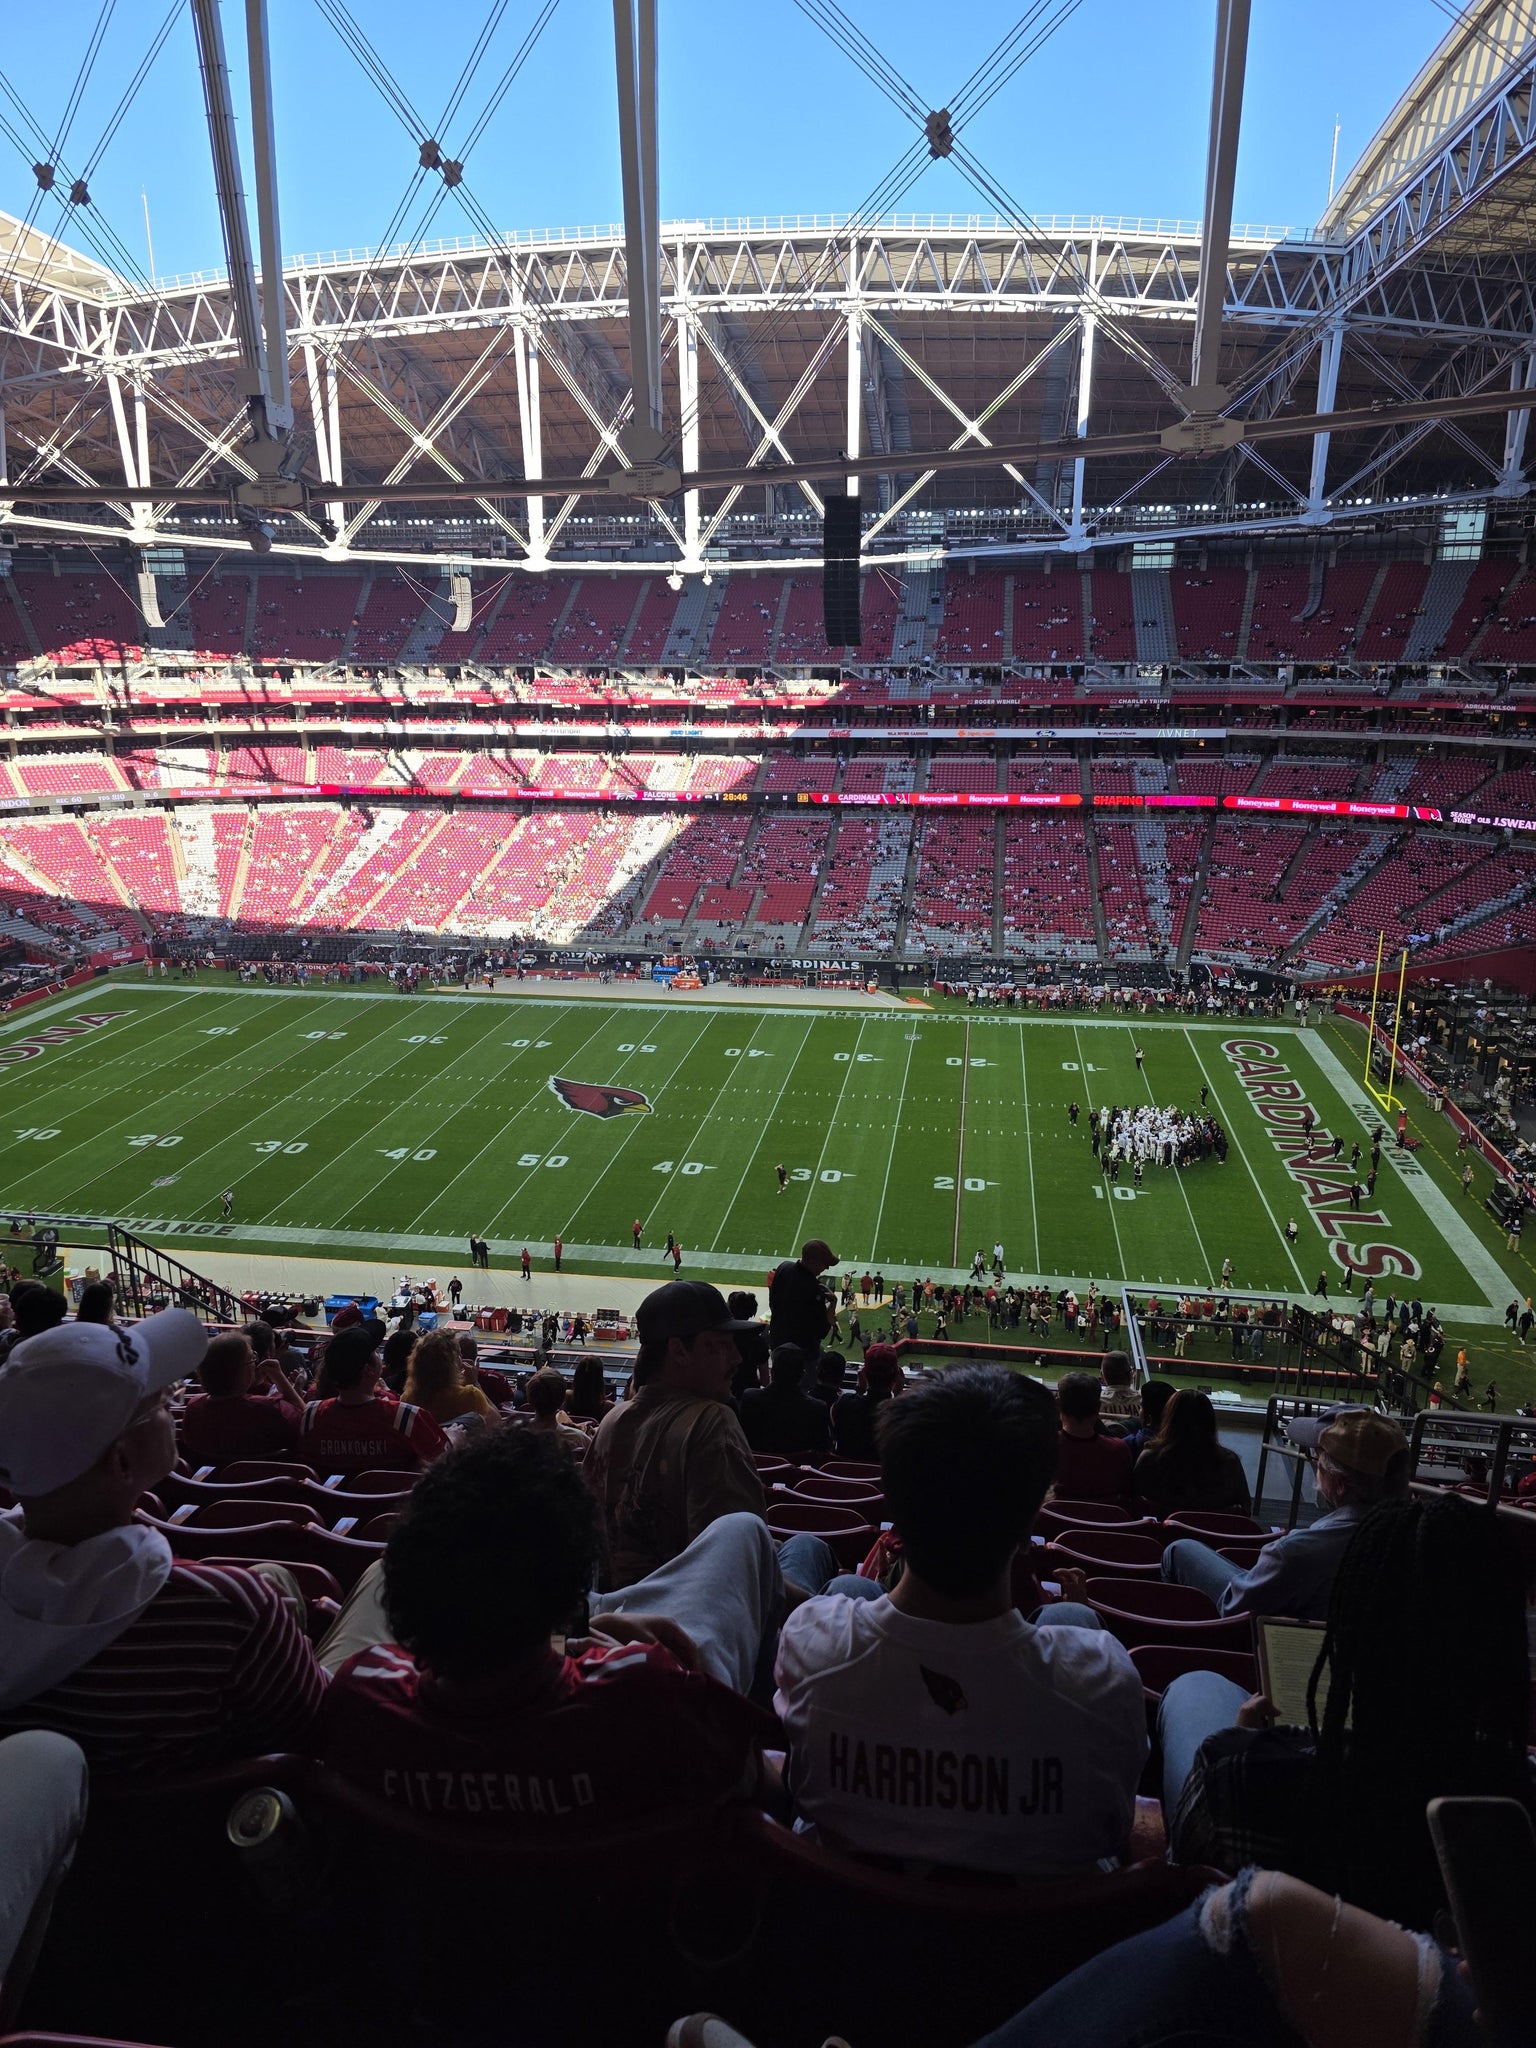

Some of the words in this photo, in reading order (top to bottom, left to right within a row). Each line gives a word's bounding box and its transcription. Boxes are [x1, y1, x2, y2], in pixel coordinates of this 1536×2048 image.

[181, 789, 221, 797] Honeywell
[232, 787, 272, 796] Honeywell
[282, 786, 322, 795] Honeywell
[472, 789, 508, 797] Honeywell
[517, 789, 554, 798] Honeywell
[564, 790, 600, 798] Honeywell
[643, 791, 677, 799] FALCONS
[686, 792, 693, 800] 0
[722, 793, 749, 801] 28:46
[822, 794, 829, 802] 0
[918, 795, 958, 804] Honeywell
[969, 795, 1009, 804] Honeywell
[1020, 795, 1061, 804] Honeywell
[1093, 795, 1143, 806] SHAPING
[1237, 798, 1280, 808] Honeywell
[1292, 801, 1337, 811] Honeywell
[1349, 804, 1396, 815] Honeywell
[1450, 811, 1476, 819] SEASON
[826, 1011, 912, 1019] INSPIRE
[923, 1014, 1009, 1022] CHANGE
[0, 1009, 138, 1072] ONA
[16, 1128, 62, 1140] 10
[128, 1134, 184, 1147] 20
[256, 1141, 309, 1154] 30
[384, 1148, 438, 1161] 40
[1220, 1039, 1423, 1281] CARDINALS
[517, 1154, 570, 1168] 50
[1384, 1146, 1424, 1176] LOVE
[652, 1161, 704, 1175] 40
[790, 1168, 842, 1183] 30
[933, 1176, 986, 1191] 20
[1091, 1185, 1137, 1200] 10
[112, 1219, 237, 1236] CHANGE
[320, 1439, 388, 1456] GRONKOWSKI
[829, 1731, 1009, 1815] HARRISON
[1019, 1756, 1065, 1816] JR
[384, 1768, 596, 1815] FITZGERALD
